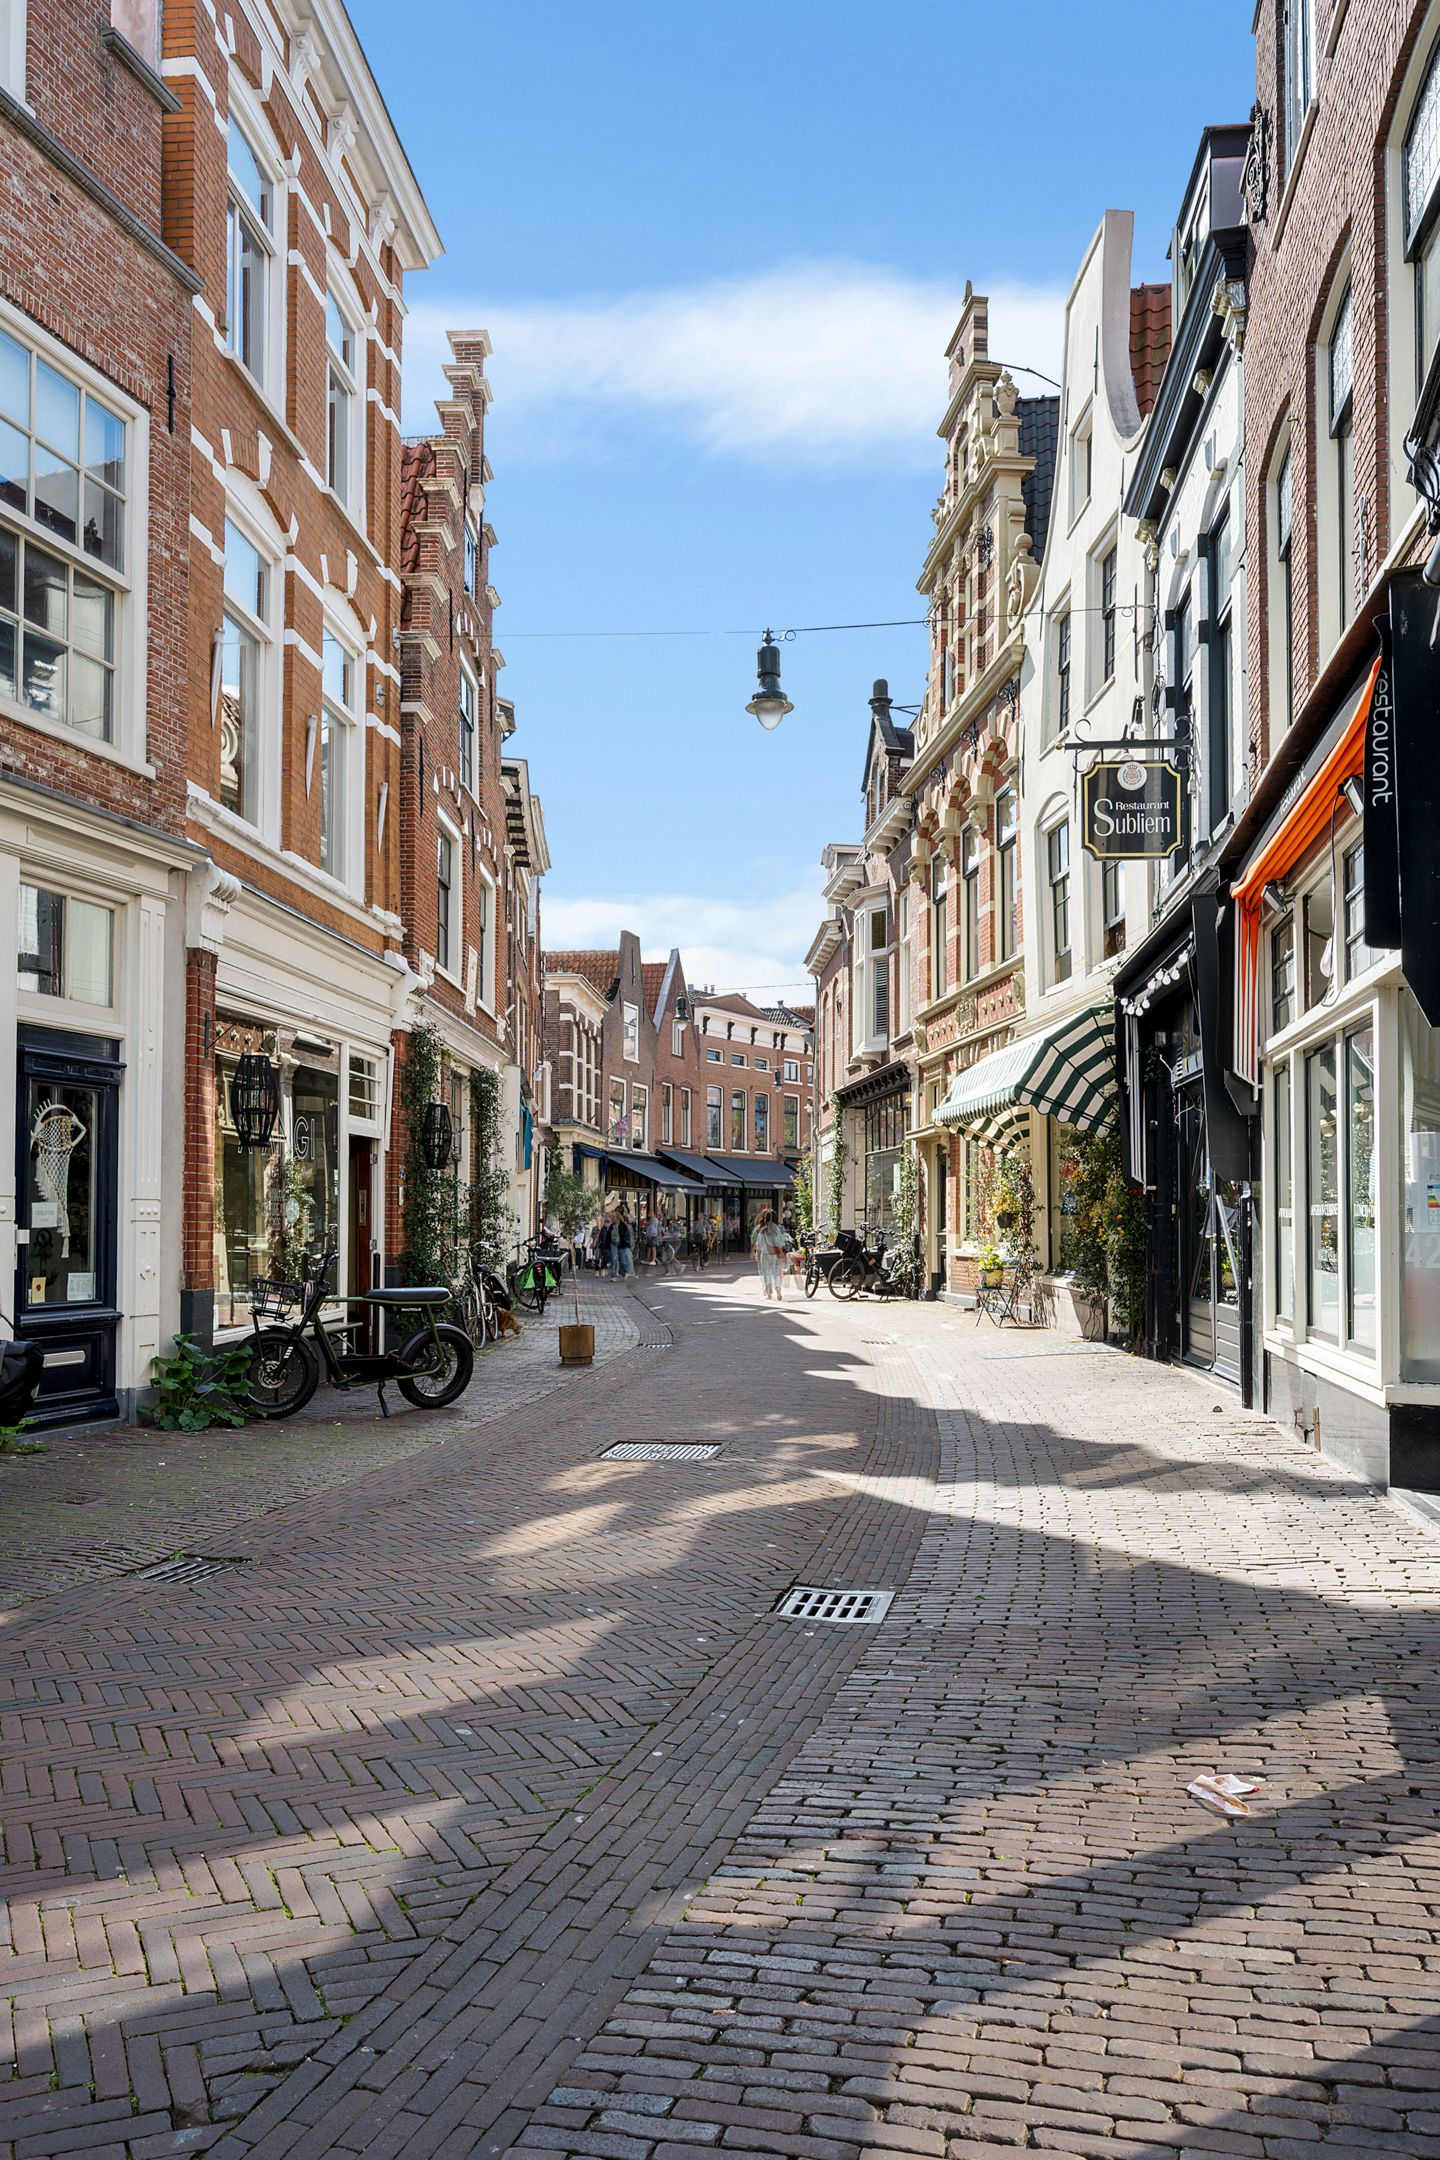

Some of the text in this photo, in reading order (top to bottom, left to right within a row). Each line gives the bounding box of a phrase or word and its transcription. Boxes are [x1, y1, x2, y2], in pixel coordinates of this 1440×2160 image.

[1093, 798, 1171, 837] Subliem
[1115, 801, 1170, 810] Restaurant
[1404, 1233, 1440, 1269] 42
